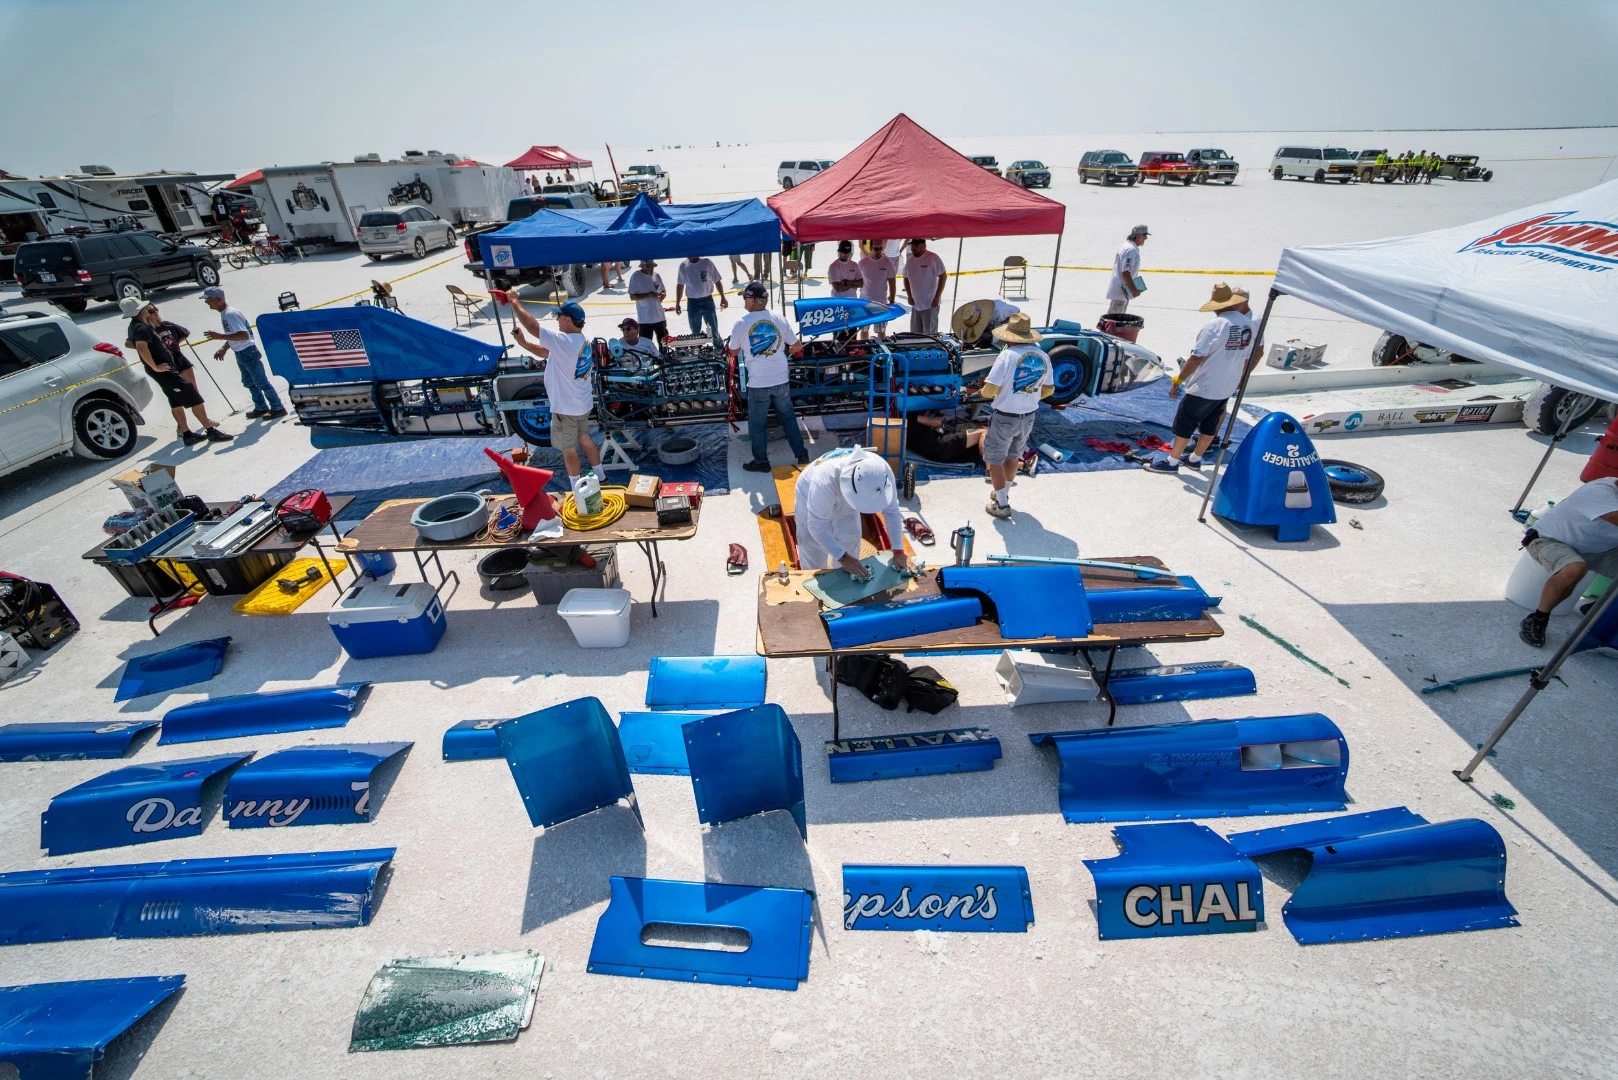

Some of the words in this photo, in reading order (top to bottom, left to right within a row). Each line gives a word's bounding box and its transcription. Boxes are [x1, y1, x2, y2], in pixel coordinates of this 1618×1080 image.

[117, 188, 144, 196] TRACER
[1520, 250, 1614, 272] EQUIPMENT
[800, 308, 835, 328] 492
[1377, 412, 1404, 421] BALL
[1463, 406, 1493, 416] OPTIMA
[1286, 444, 1300, 458] 2
[1262, 451, 1320, 468] CHALLENGER
[1170, 752, 1233, 761] THOMPSONS
[126, 797, 201, 833] Da
[1123, 881, 1257, 928] CHAL
